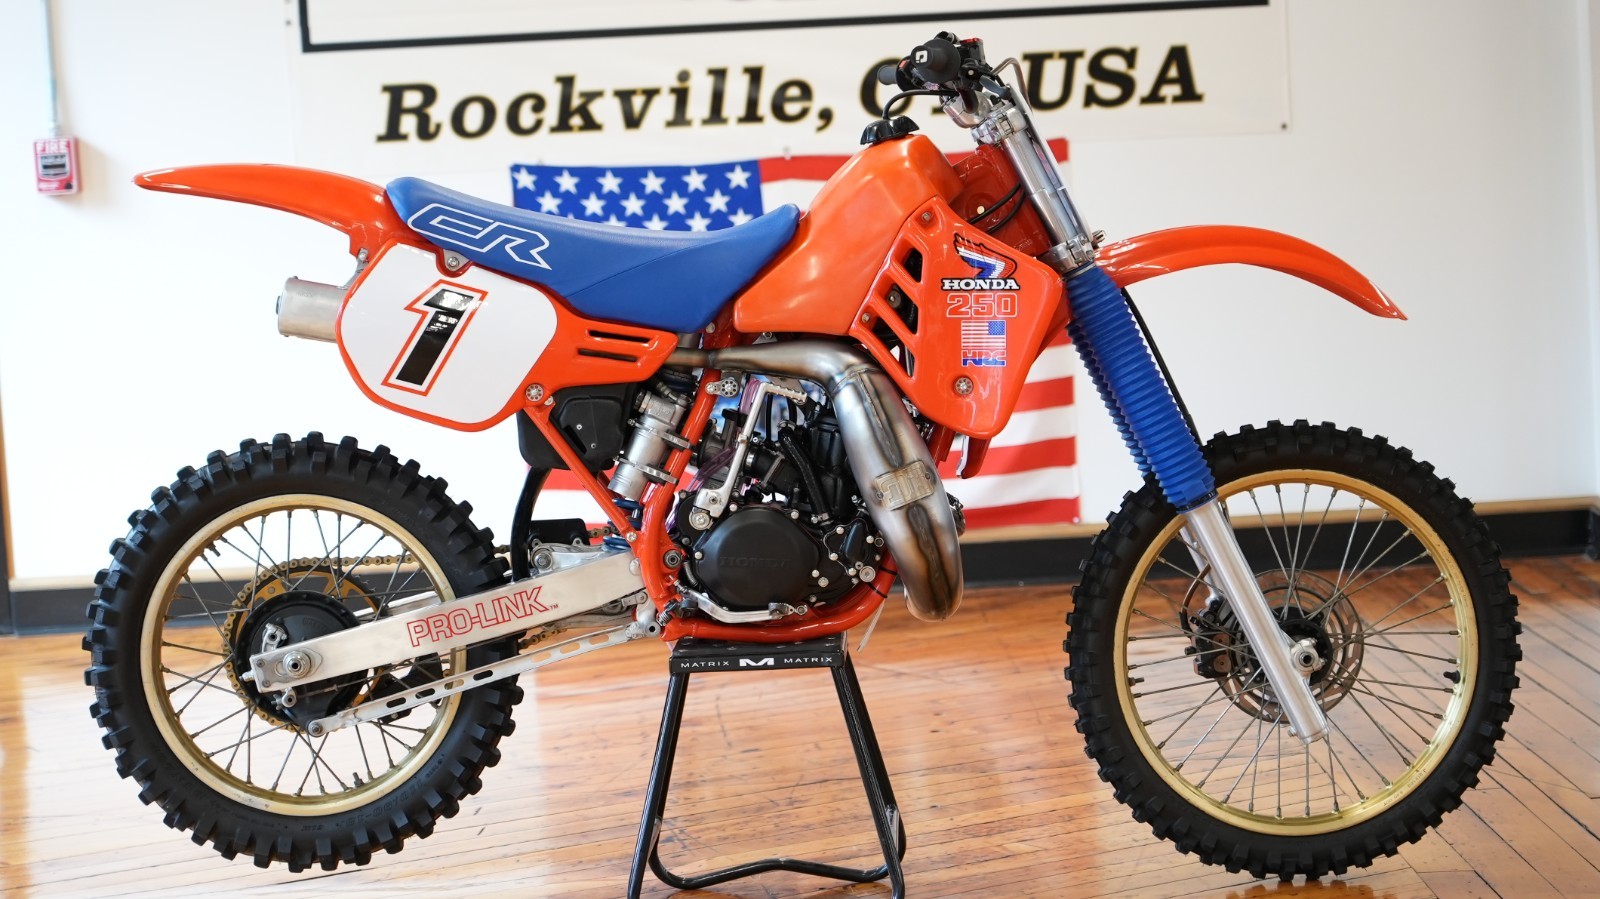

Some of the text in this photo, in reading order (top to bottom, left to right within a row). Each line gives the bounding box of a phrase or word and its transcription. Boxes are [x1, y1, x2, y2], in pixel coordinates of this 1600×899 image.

[375, 65, 834, 143] Rockville,
[1021, 44, 1205, 112] USA
[407, 203, 552, 270] CR
[941, 278, 1020, 290] HONDA
[946, 293, 1018, 318] 250
[381, 279, 489, 397] 1
[961, 350, 1007, 367] HRC
[406, 586, 550, 648] PRO-LINK
[680, 660, 730, 668] MATRIX
[783, 656, 833, 664] MATRIX
